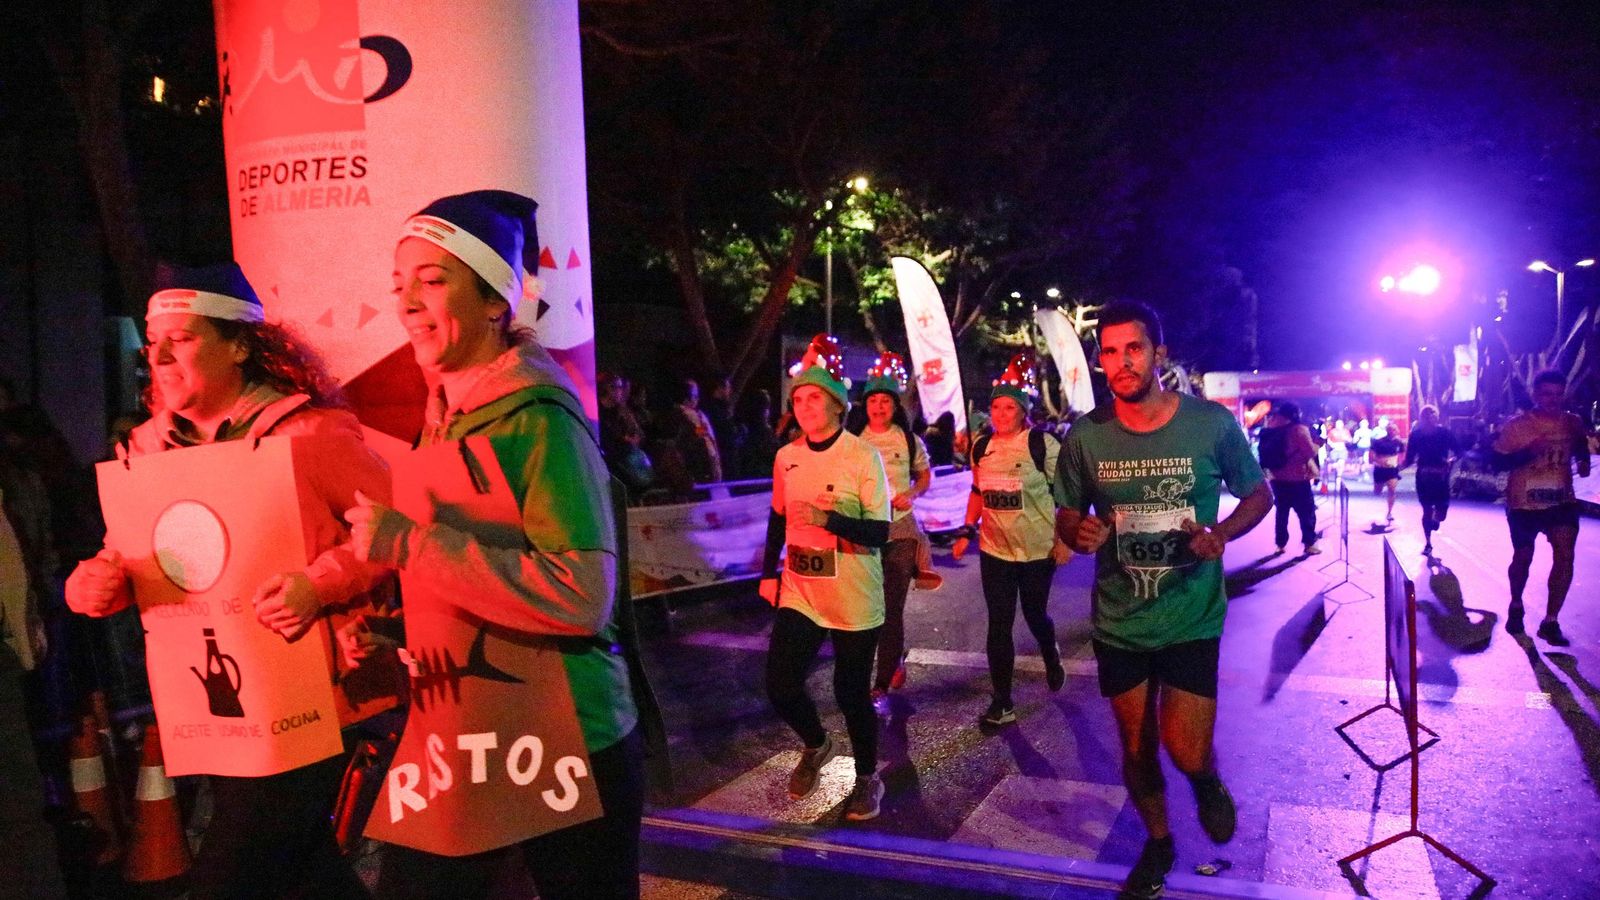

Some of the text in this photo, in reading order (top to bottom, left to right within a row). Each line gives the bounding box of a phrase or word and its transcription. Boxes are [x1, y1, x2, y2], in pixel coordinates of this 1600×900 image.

[238, 155, 369, 192] DEPORTES
[240, 184, 372, 218] DE ALMERIA
[1098, 458, 1192, 469] XVII SAN SILVESTRE
[1098, 466, 1193, 478] CIUDAD DE ALMERÍA
[222, 597, 244, 616] DE
[172, 723, 212, 740] ACEITE
[271, 709, 321, 736] COCINA
[388, 732, 588, 824] RSTOS
